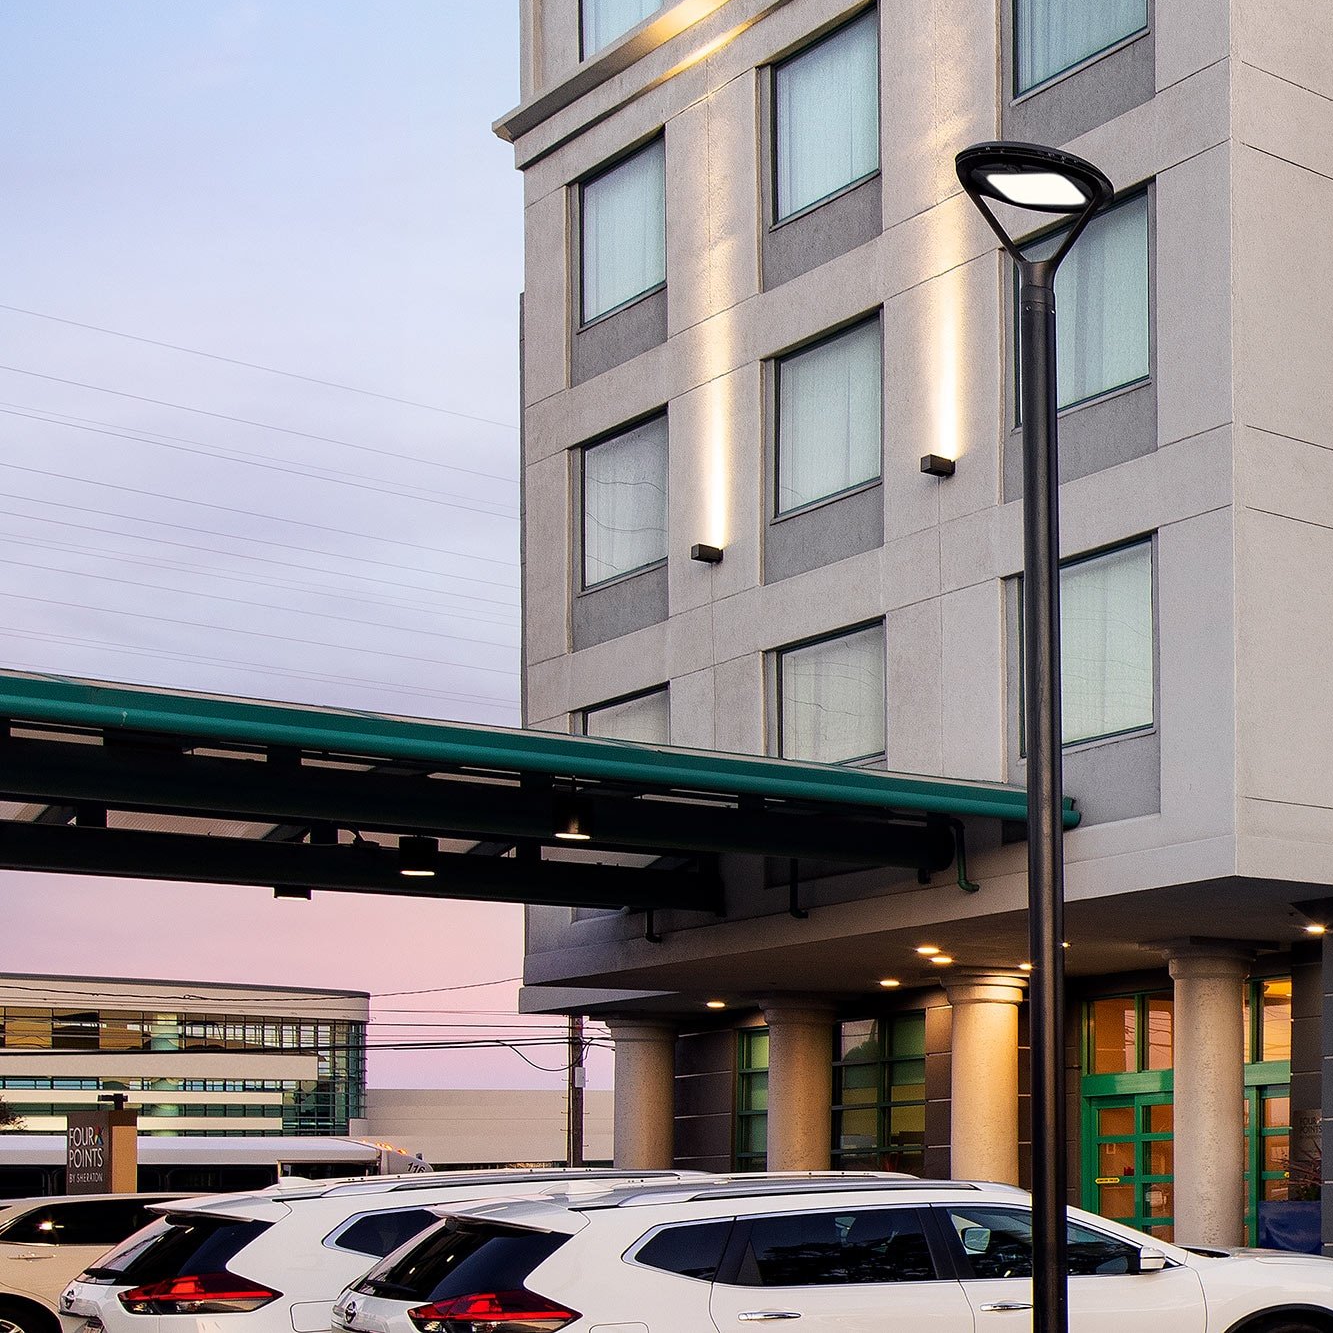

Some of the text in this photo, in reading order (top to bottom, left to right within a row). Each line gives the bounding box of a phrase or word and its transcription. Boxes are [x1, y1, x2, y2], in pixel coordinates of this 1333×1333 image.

[69, 1127, 95, 1147] FOUR
[69, 1148, 104, 1168] POINTS
[69, 1172, 103, 1183] BY SHERATON
